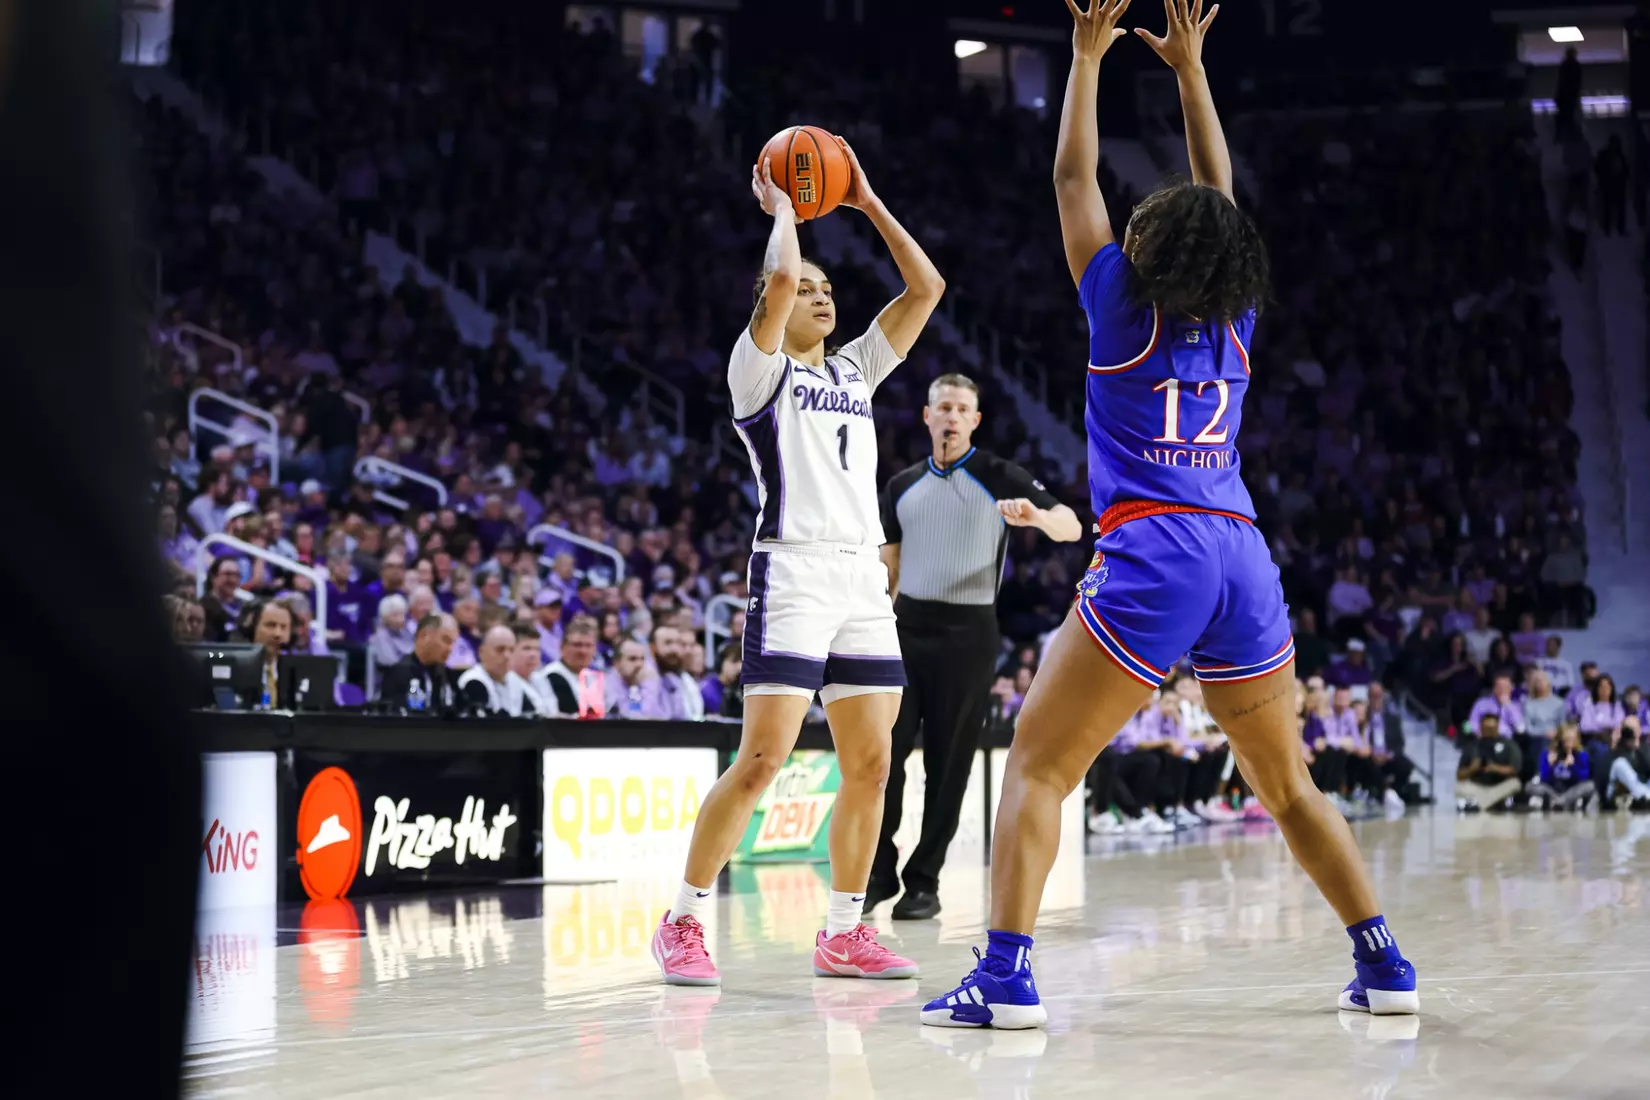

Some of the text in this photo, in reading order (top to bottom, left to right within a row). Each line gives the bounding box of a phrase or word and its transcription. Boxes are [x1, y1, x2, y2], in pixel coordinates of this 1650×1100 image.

[794, 152, 812, 204] ELITE
[1152, 377, 1230, 444] 12
[836, 424, 849, 471] 1
[365, 795, 517, 877] Pizza Hut
[552, 775, 700, 861] QDOBA
